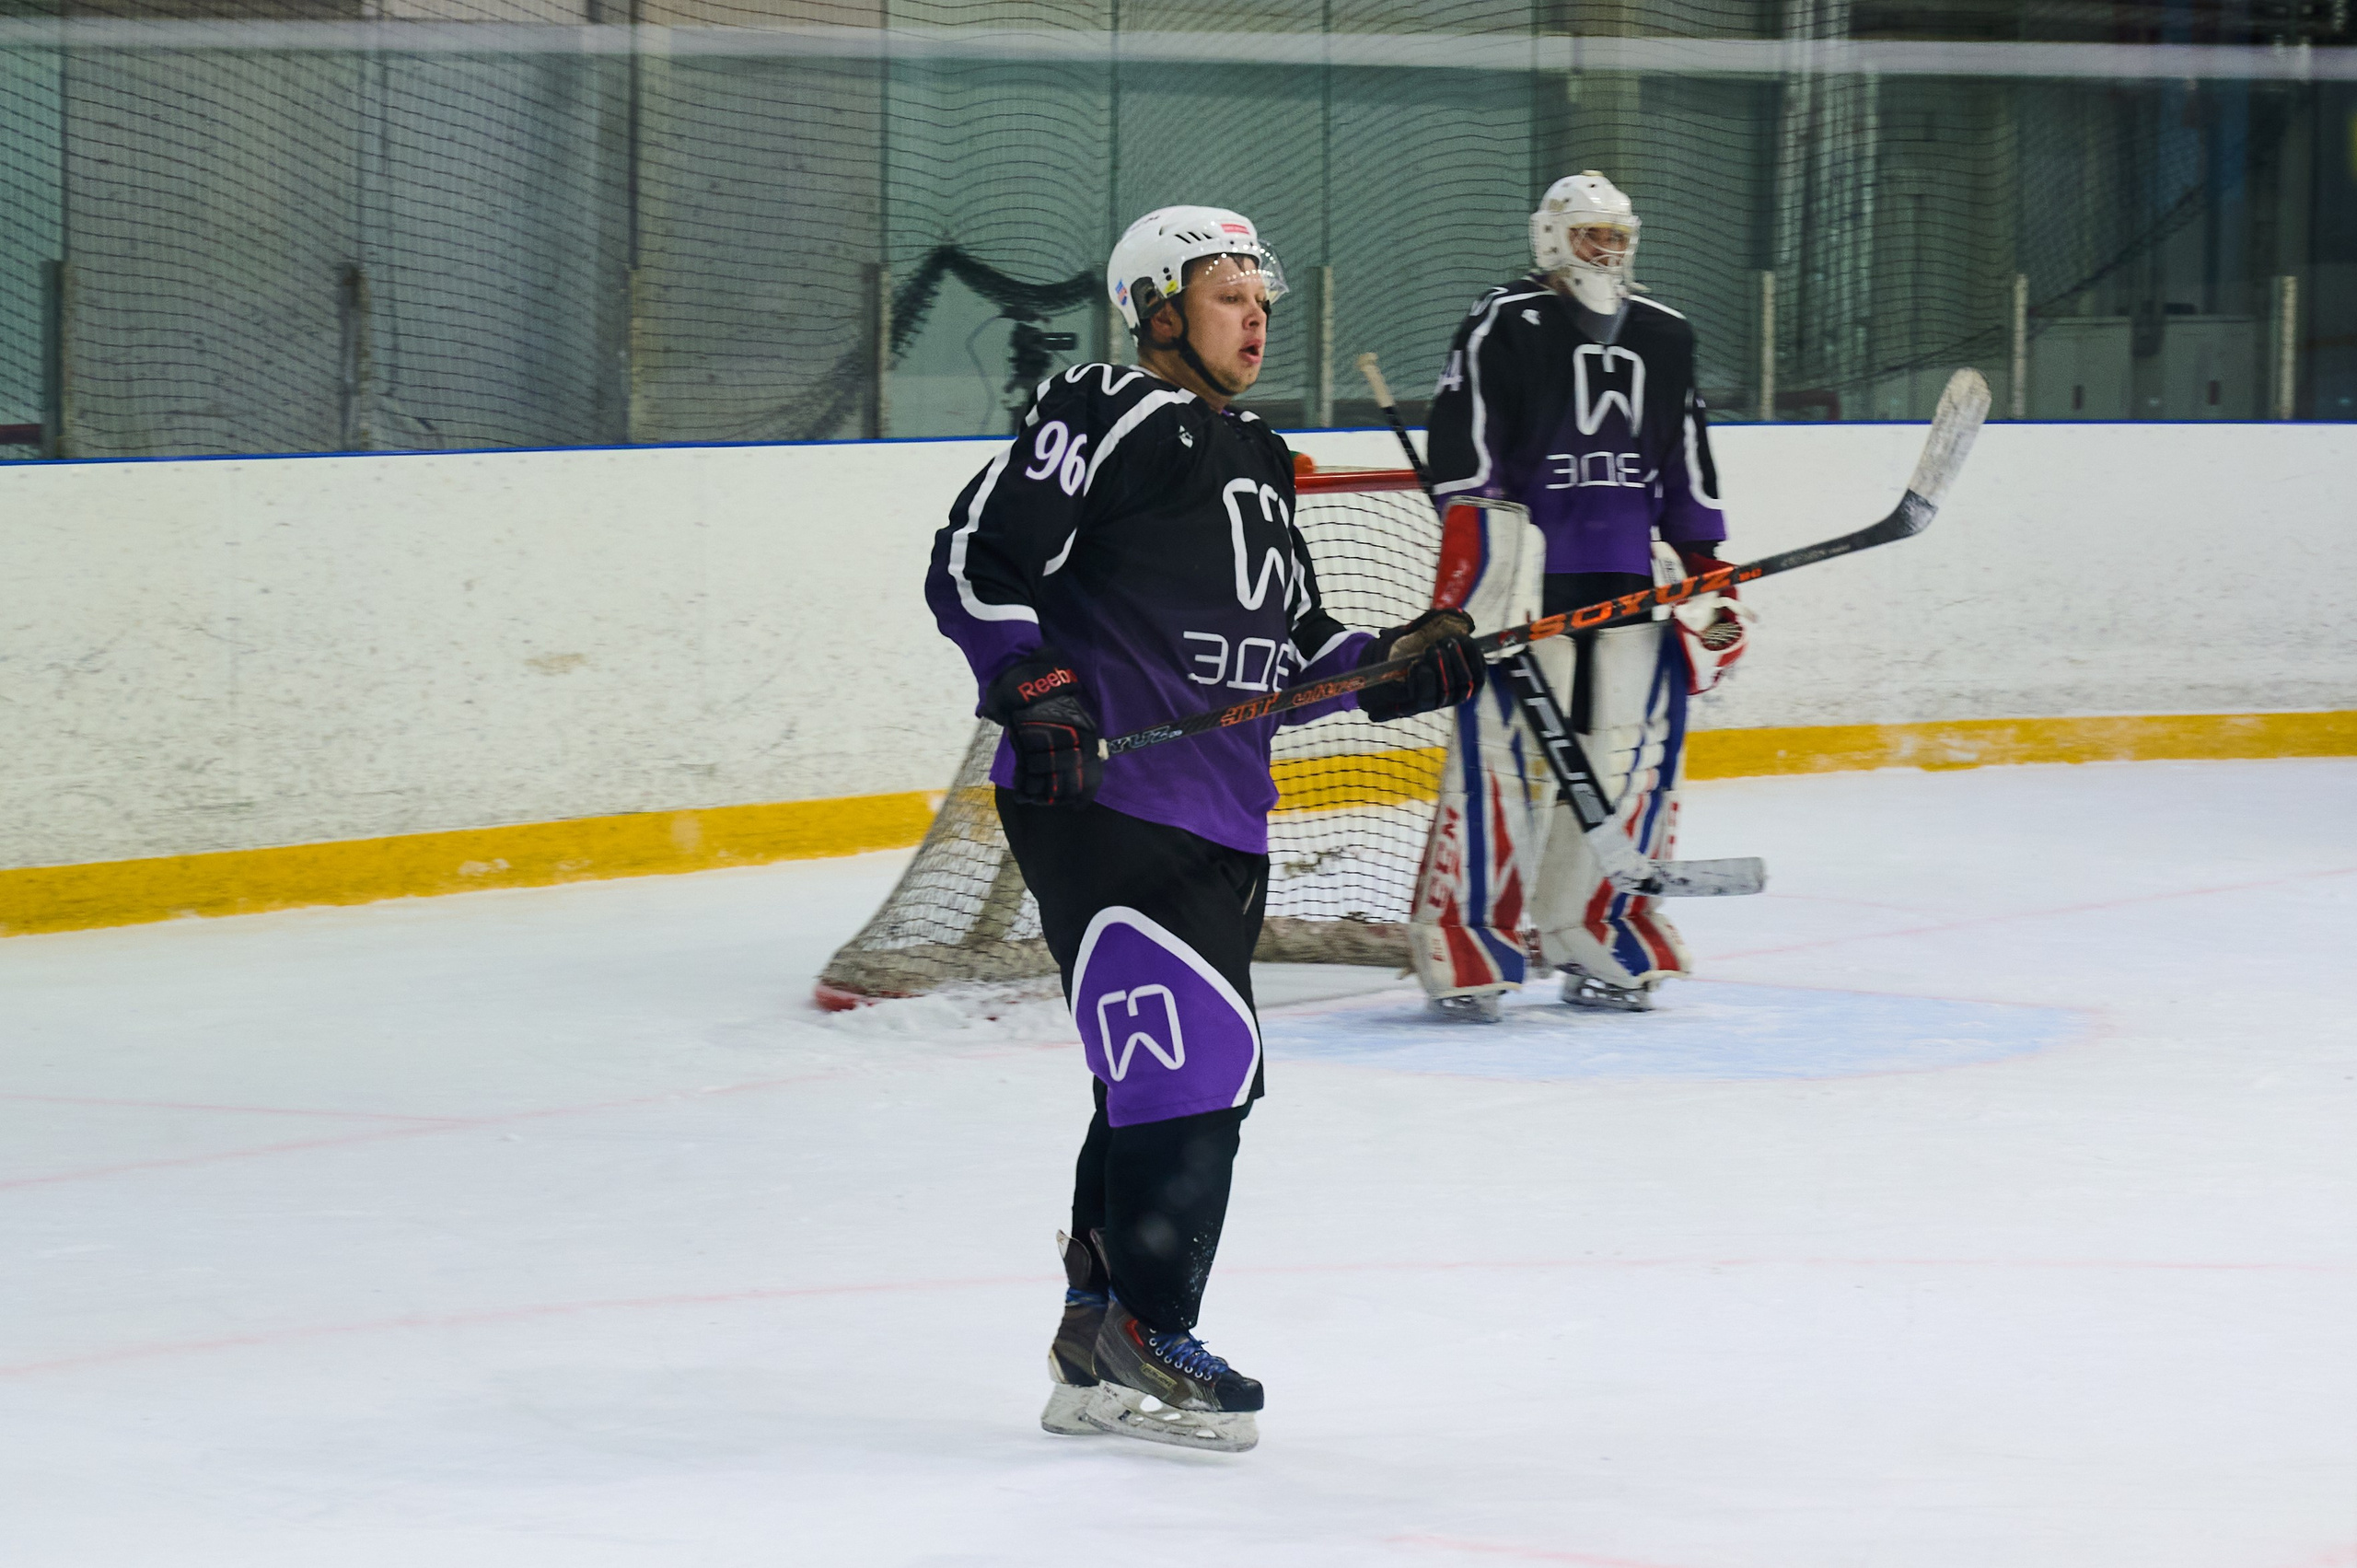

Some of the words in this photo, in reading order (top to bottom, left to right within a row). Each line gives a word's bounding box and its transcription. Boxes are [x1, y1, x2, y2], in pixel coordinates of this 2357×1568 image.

[1025, 420, 1087, 496] 96
[1546, 451, 1663, 498] ЗДЕ
[1528, 566, 1734, 641] SOYUZ
